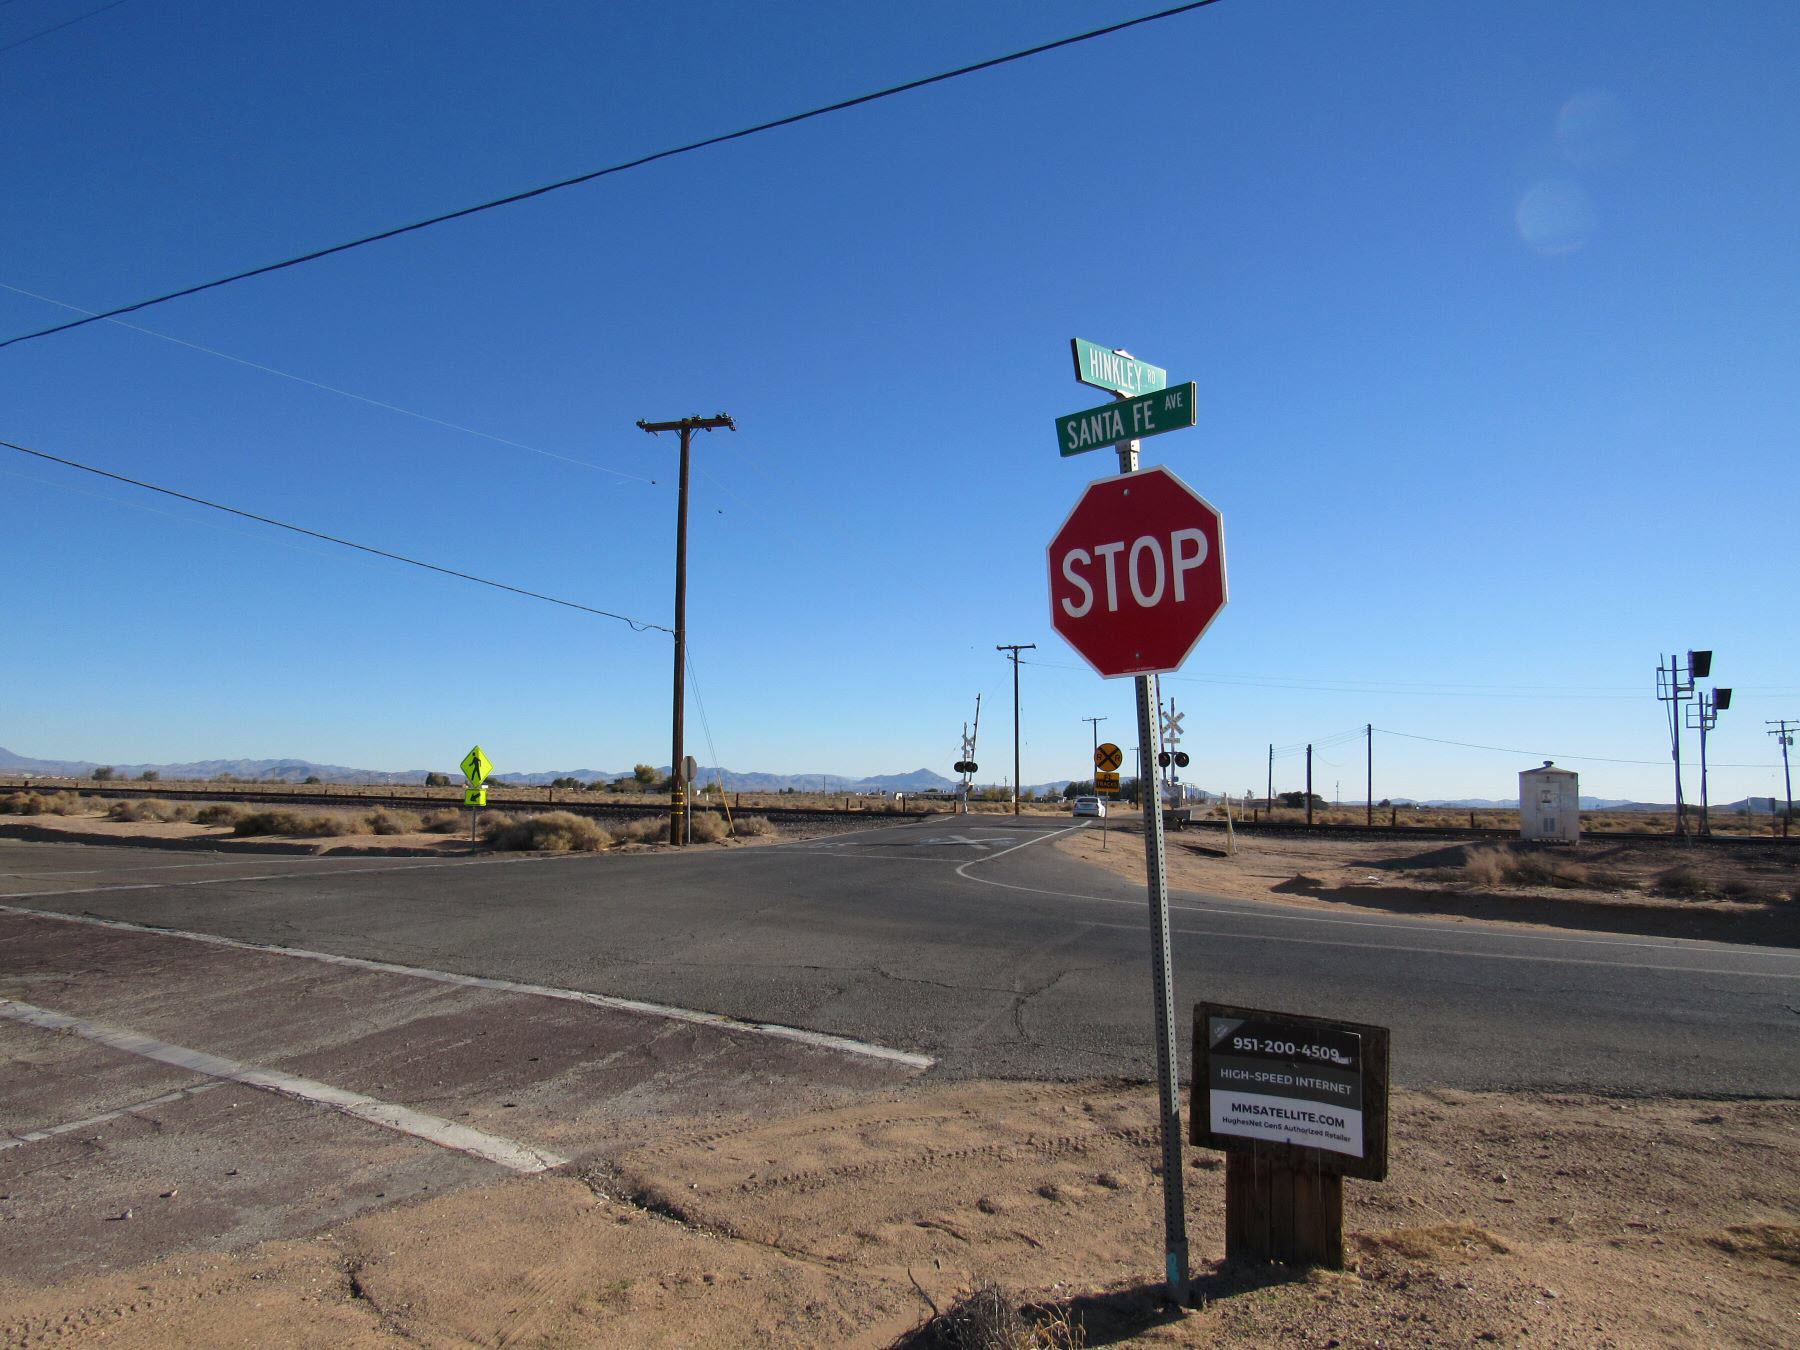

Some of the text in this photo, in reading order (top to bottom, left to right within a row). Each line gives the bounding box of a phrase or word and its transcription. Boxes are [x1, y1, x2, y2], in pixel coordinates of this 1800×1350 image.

[1089, 348, 1156, 392] HINKLEY RD
[1067, 392, 1183, 449] SANTA FE AVE
[1061, 528, 1208, 618] STOP
[1233, 1037, 1340, 1061] 951-200-4509
[1220, 1068, 1352, 1095] HIGH-SPEED INTERNET
[1231, 1103, 1345, 1128] MMSATELLITE.COM
[1222, 1117, 1262, 1128] HughesNet
[1284, 1124, 1323, 1137] Authorized
[1325, 1131, 1351, 1142] Retailer
